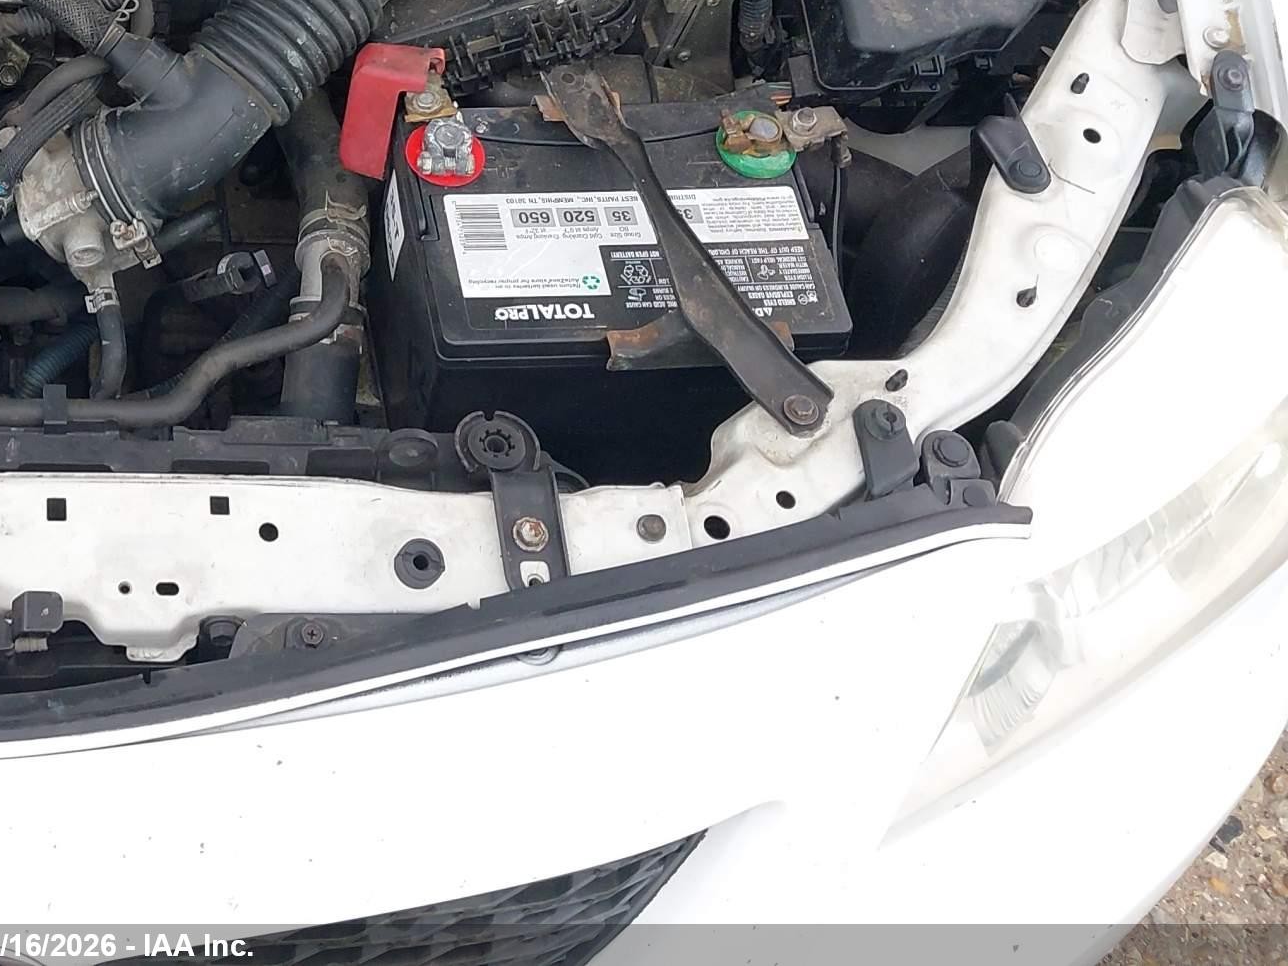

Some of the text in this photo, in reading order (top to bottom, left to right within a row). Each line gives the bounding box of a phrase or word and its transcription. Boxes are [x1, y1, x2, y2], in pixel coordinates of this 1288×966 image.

[518, 211, 551, 224] 650
[563, 210, 595, 223] 520
[612, 210, 631, 222] 35
[495, 303, 595, 321] TOTALPRO
